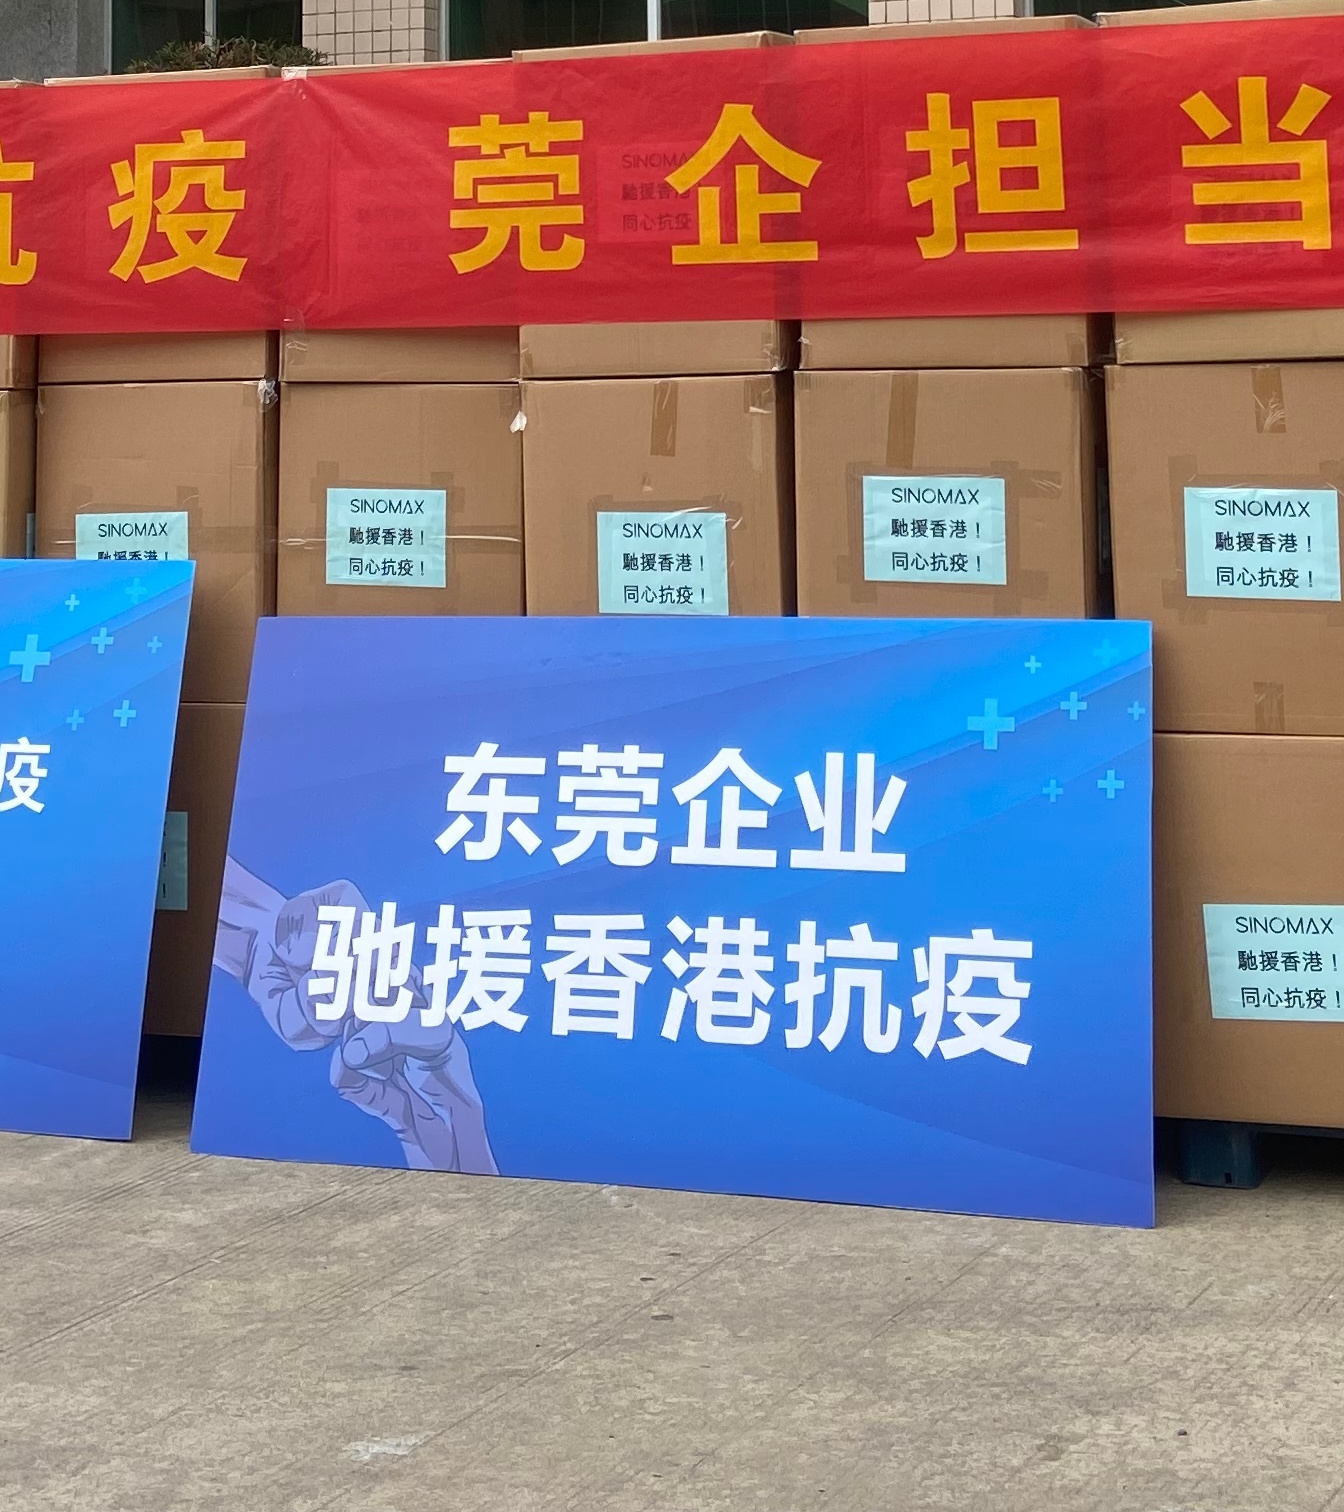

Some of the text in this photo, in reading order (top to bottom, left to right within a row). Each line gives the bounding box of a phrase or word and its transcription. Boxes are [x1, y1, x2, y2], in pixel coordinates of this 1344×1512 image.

[448, 76, 1332, 274] 莞企担当
[892, 488, 979, 504] SINOMAX
[351, 499, 424, 514] SINOMAX
[1215, 500, 1310, 517] SINOMAX
[98, 523, 167, 537] SINOMAX
[349, 527, 423, 545] 馳援香港！
[623, 523, 702, 538] SINOMAX
[891, 518, 979, 538] 馳援香港！
[1215, 531, 1311, 552] 馳援香港！
[349, 558, 424, 576] 同心抗疫！
[623, 553, 703, 571] 馳援香港！
[892, 552, 980, 572] 同心抗疫！
[1217, 567, 1312, 588] 同心抗疫！
[624, 585, 704, 604] 同心抗疫！
[434, 741, 908, 874] 东莞企业
[1236, 917, 1333, 934] SINOMAX
[1238, 950, 1337, 972] 馳援香港！
[307, 901, 1034, 1066] 驰援香港抗疫
[1241, 987, 1340, 1009] 同心抗疫！
